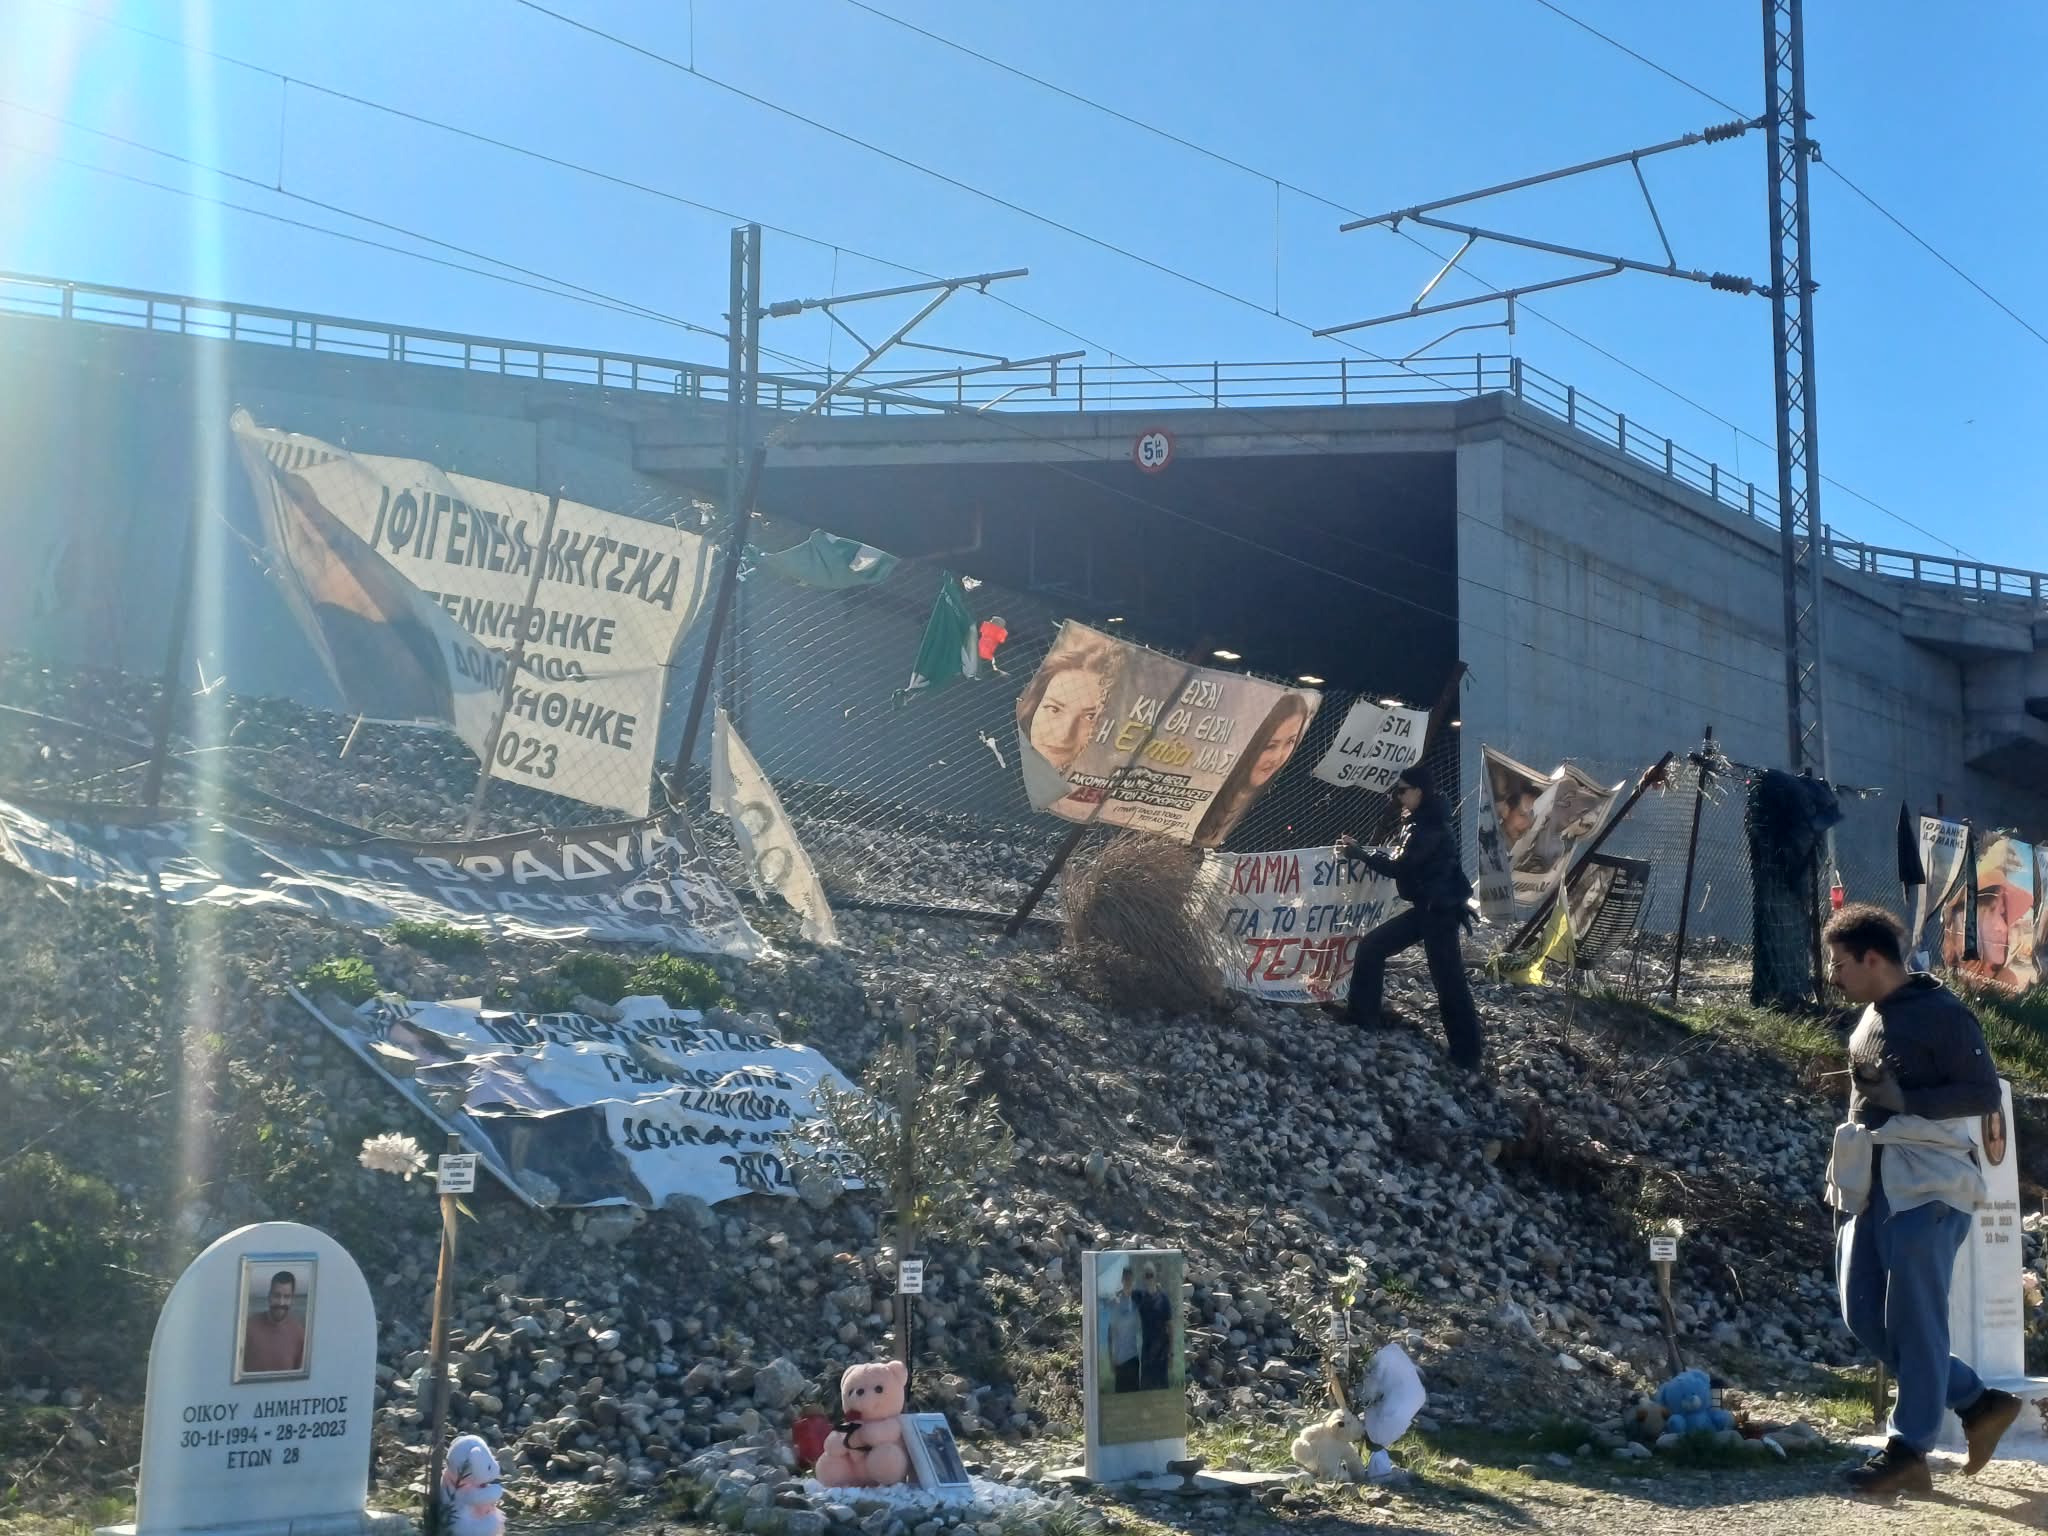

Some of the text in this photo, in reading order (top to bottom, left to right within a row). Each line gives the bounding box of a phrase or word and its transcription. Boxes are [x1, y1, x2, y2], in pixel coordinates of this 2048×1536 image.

[1144, 442, 1154, 460] 5
[371, 485, 681, 611] ΙΦΙΓΕΝΕΙΑ ΜΗΤΣΚΑ
[426, 592, 616, 655] ΕΝΝΗΘΗΚΕ
[1180, 680, 1224, 709] ΕΙΣΑΙ
[1096, 720, 1115, 743] Η
[1129, 695, 1235, 743] ΚΑΙ ΘΑ ΕΙΣΑΙ
[1377, 715, 1412, 737] STA
[493, 728, 559, 779] 023
[1339, 736, 1417, 764] LA JSTICIA
[1229, 854, 1301, 895] ΚΑΜΙΑ
[1219, 907, 1260, 937] ΓΙΑ
[1272, 906, 1297, 934] ΤΟ
[183, 1396, 348, 1423] ΟΙΚΟΥ ΔΗΜΗΤΡΙΟΣ
[181, 1426, 258, 1448] 30-11-1994
[276, 1419, 347, 1441] 28-2-2023
[227, 1448, 299, 1469] ΕΤΩΝ 28
